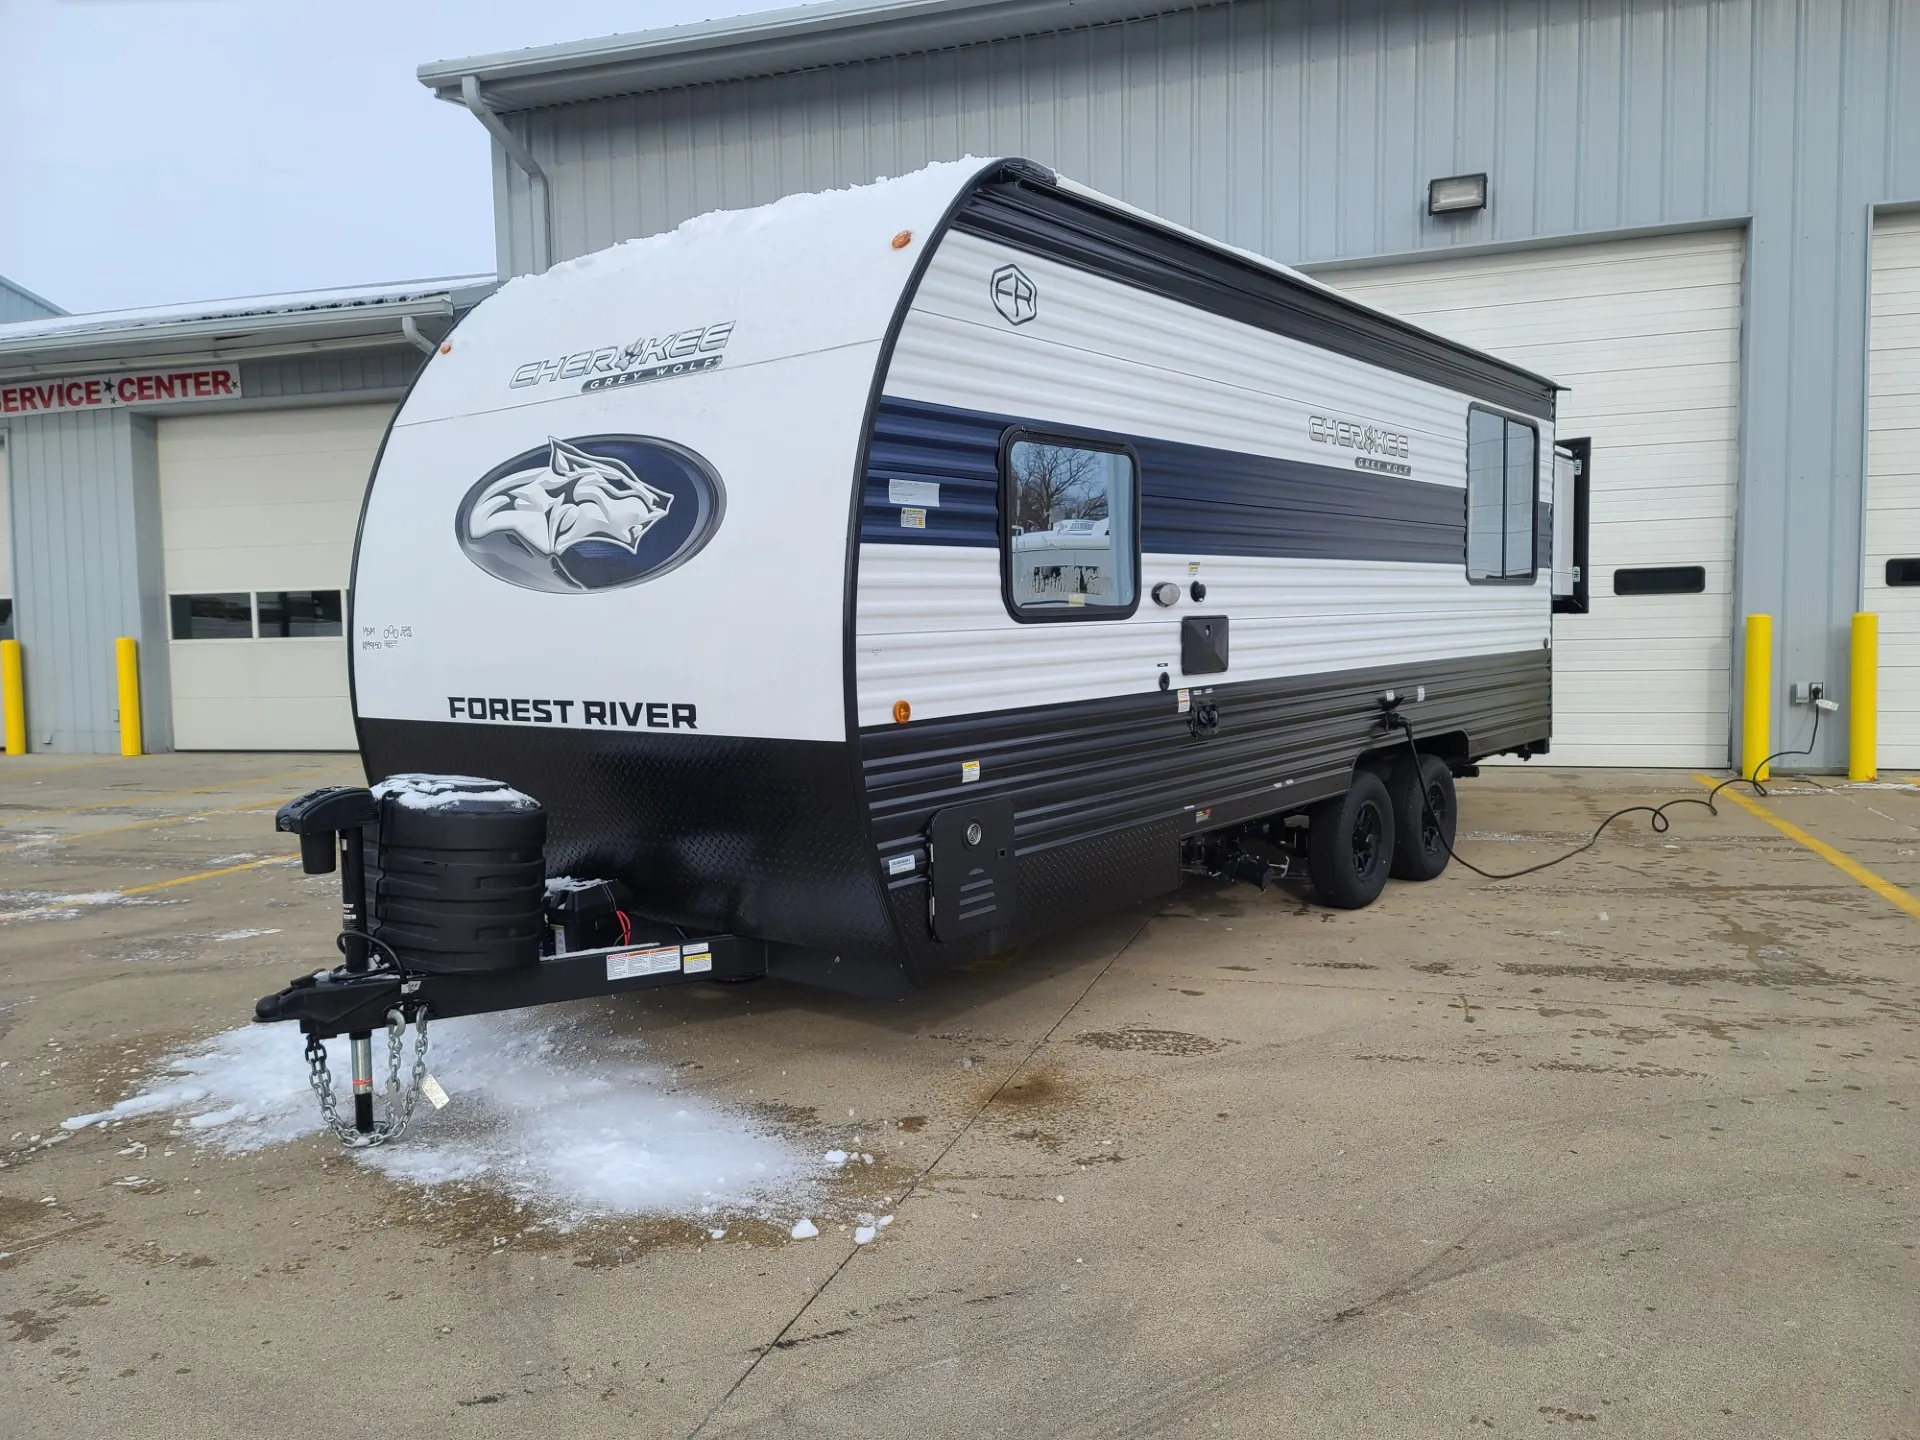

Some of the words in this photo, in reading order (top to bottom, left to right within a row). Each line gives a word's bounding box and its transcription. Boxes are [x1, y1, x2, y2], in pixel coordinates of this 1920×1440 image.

[589, 371, 643, 390] GREY
[655, 359, 714, 377] WOLF
[0, 380, 102, 414] ERVICE
[117, 370, 233, 402] CENTER
[1358, 459, 1382, 470] GREY
[1386, 462, 1409, 474] WOLF
[447, 696, 575, 725] FOREST
[582, 700, 698, 730] RIVER
